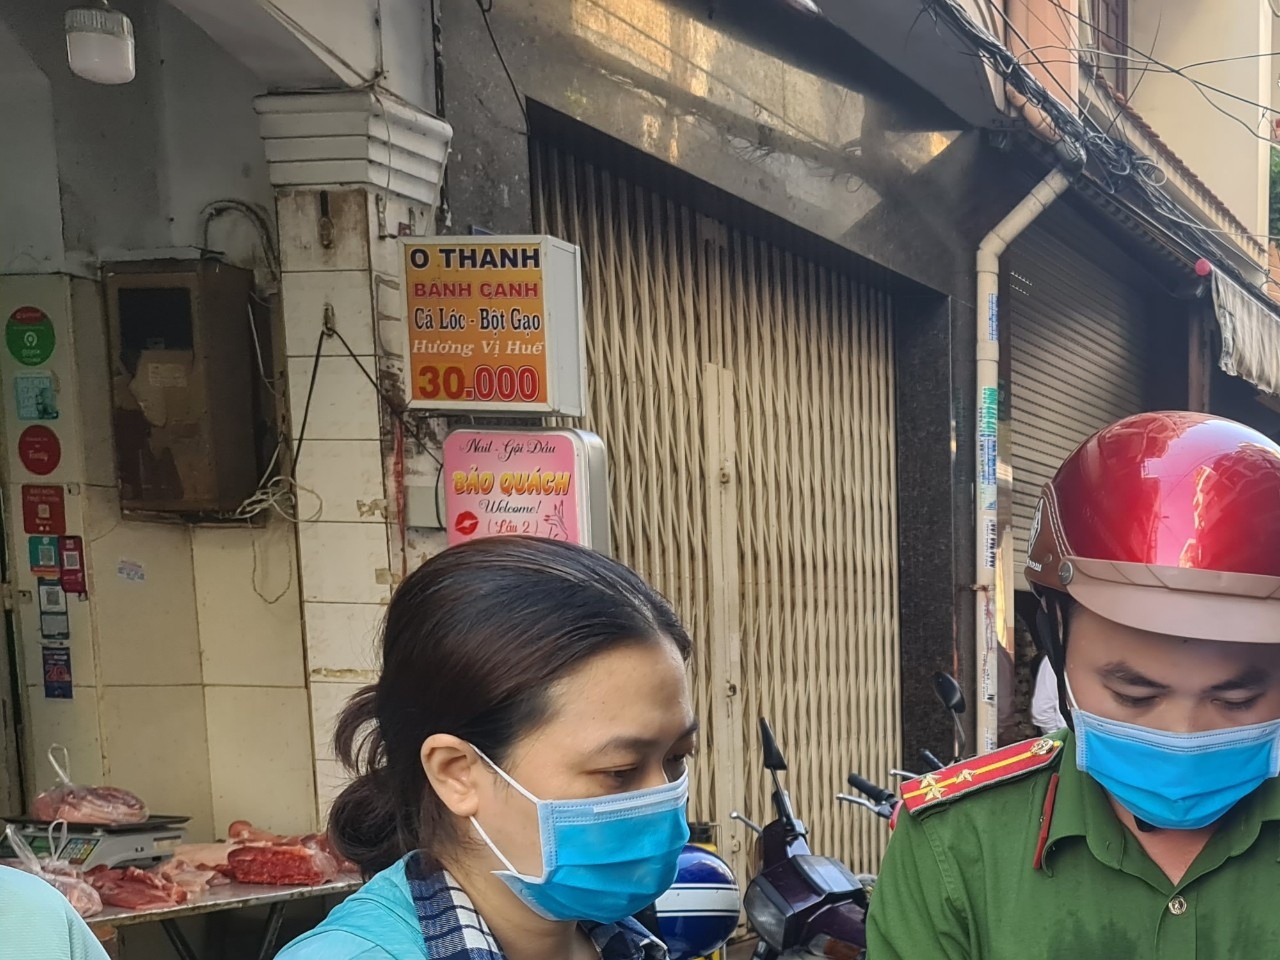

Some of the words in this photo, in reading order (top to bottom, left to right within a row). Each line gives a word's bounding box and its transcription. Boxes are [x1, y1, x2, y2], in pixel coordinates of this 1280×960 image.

[410, 248, 430, 269] O
[439, 247, 541, 269] THANH
[480, 282, 538, 298] CANH
[414, 307, 434, 330] Cá
[439, 307, 466, 330] Lóc
[479, 308, 506, 336] Bột
[510, 307, 541, 337] Gạo
[412, 340, 474, 357] Hương
[482, 340, 500, 358] Vị
[506, 340, 544, 355] Huế
[418, 364, 540, 401] 30.000
[452, 464, 495, 495] BẢO
[500, 468, 572, 497] QUÁCH
[479, 499, 542, 514] Welcome!
